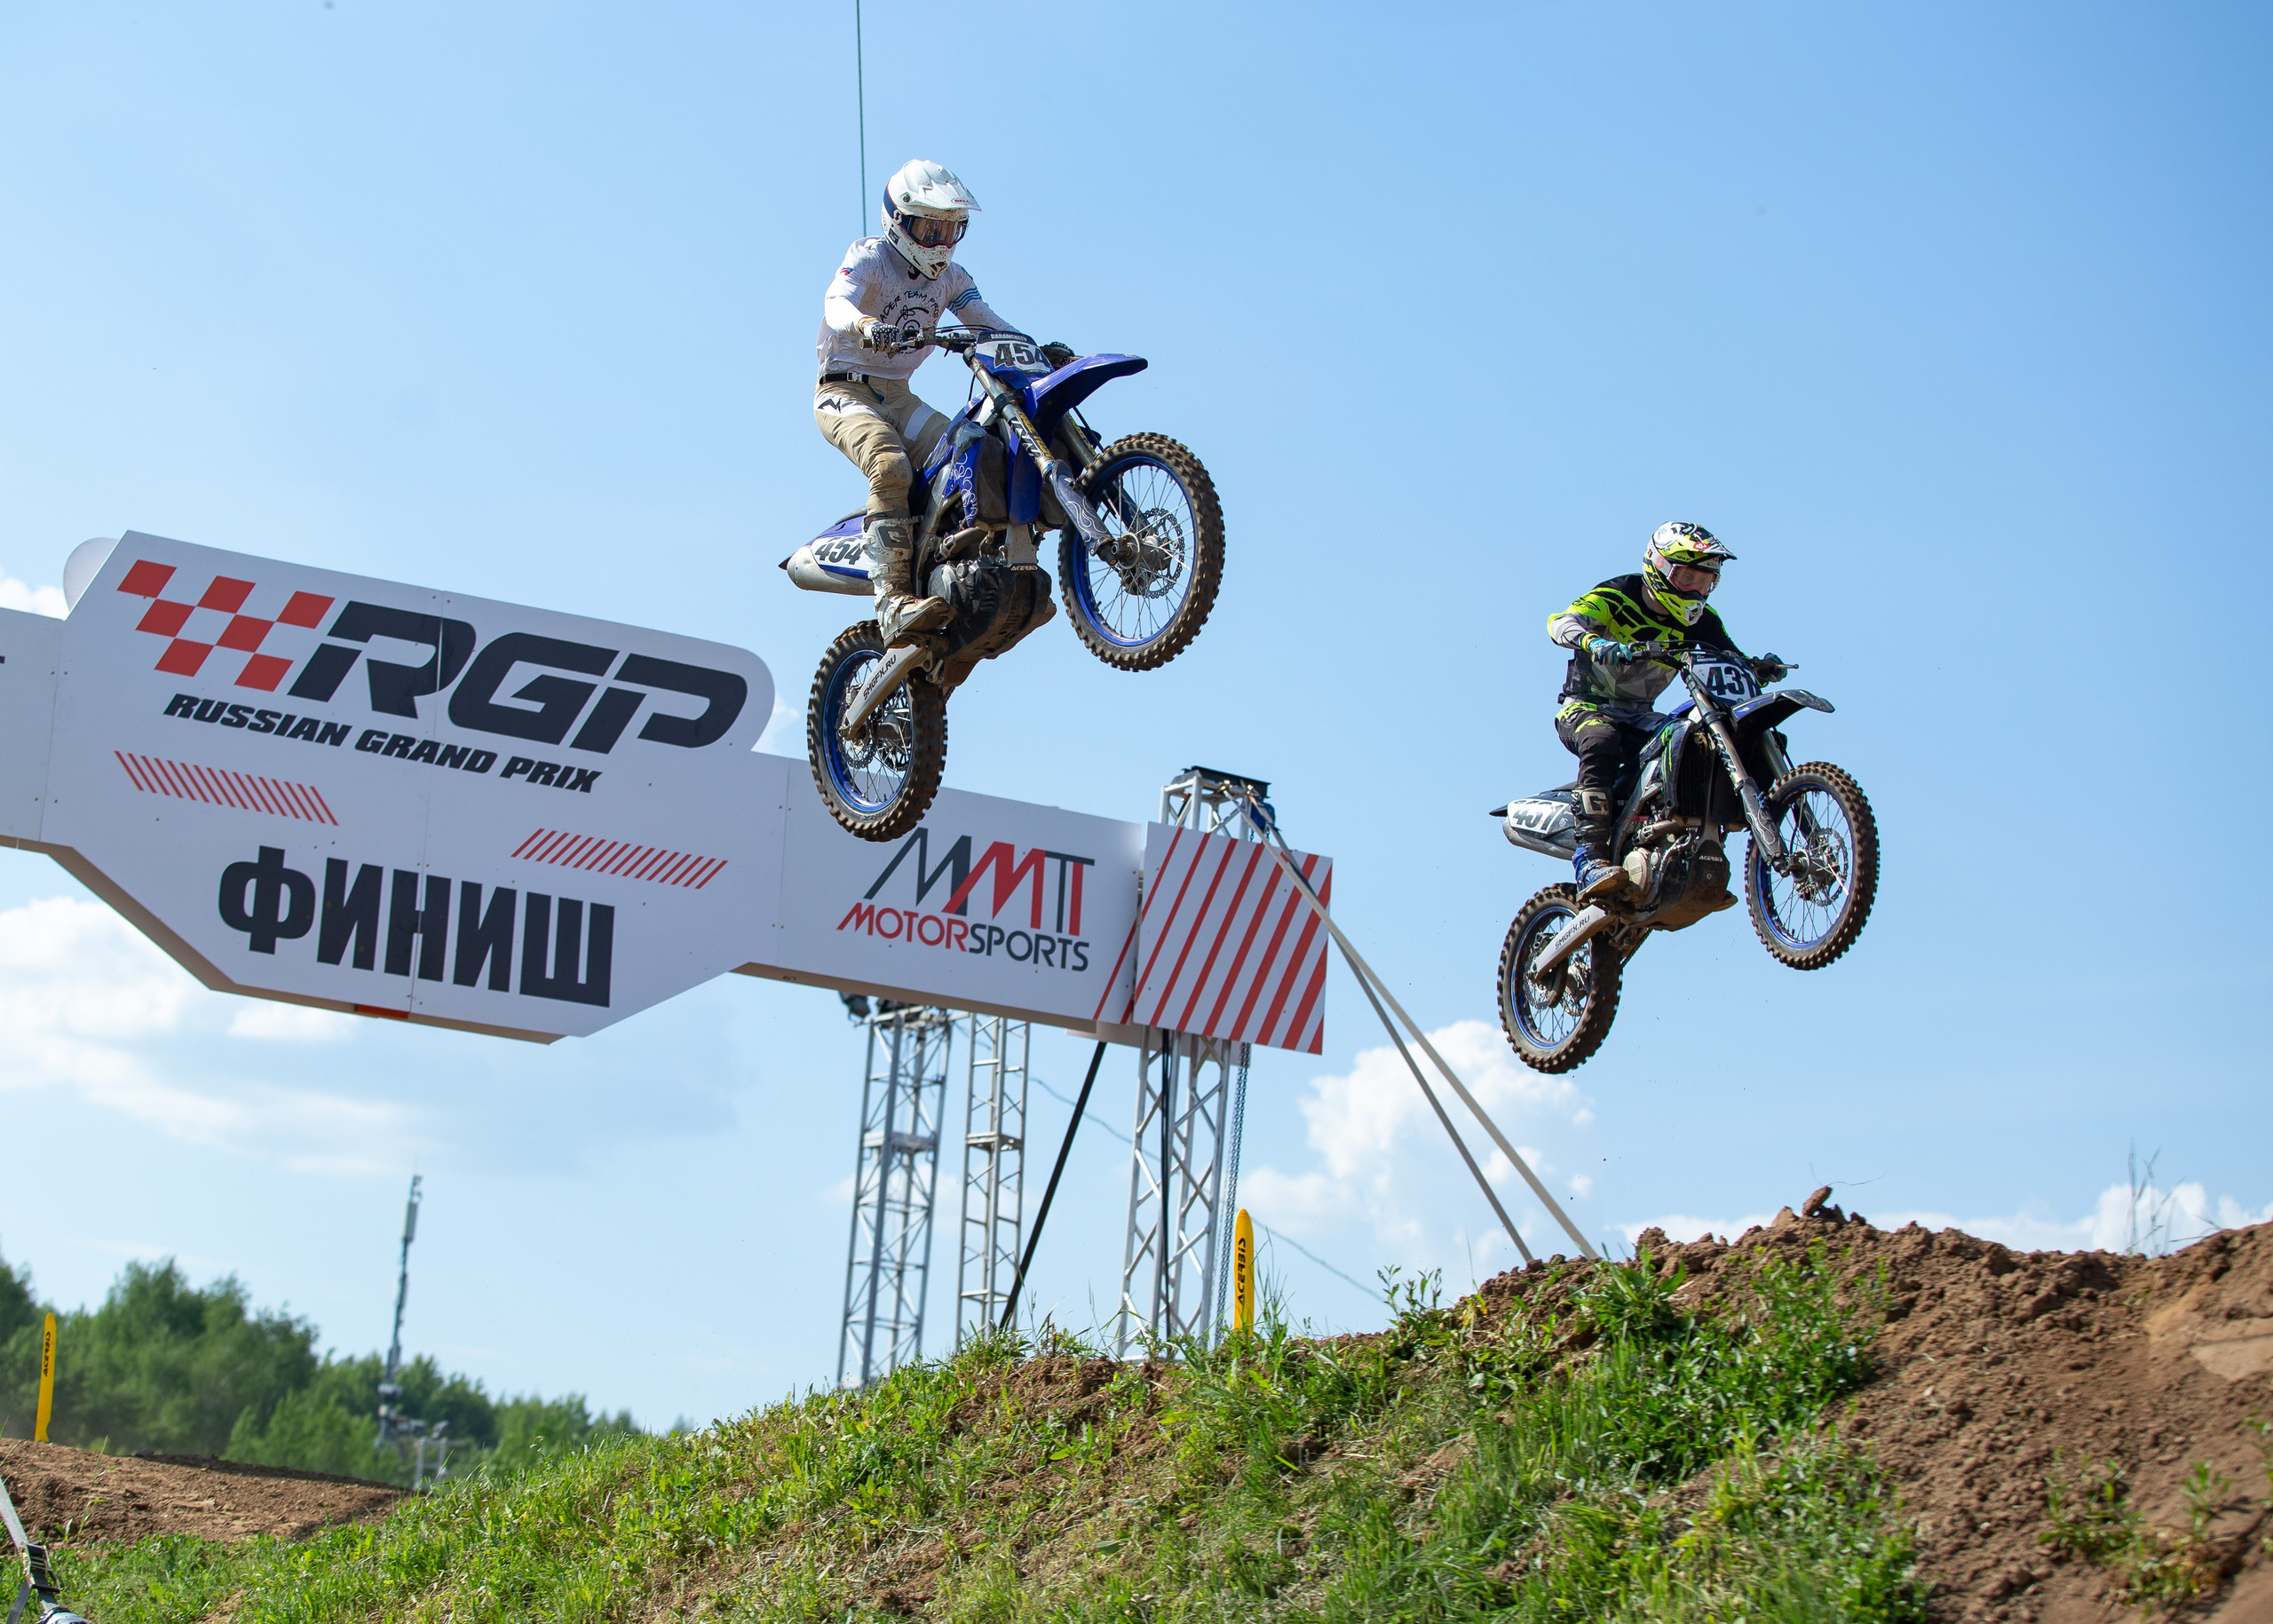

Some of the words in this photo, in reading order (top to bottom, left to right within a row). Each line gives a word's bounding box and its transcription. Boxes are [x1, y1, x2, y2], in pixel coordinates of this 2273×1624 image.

[903, 289, 928, 303] TEAM
[994, 343, 1053, 369] 454
[814, 536, 864, 566] 454
[288, 600, 748, 754] RGP
[863, 654, 897, 701] SMGFX.RU
[162, 693, 352, 748] RUSSIAN
[354, 728, 499, 775] GRAND
[499, 755, 602, 794] PRIX
[218, 844, 616, 1007] ФИНИШ
[836, 901, 1089, 972] MOTORSPORTS
[1554, 915, 1591, 950] SMGFX.RU
[1238, 1237, 1247, 1306] ACERBIS
